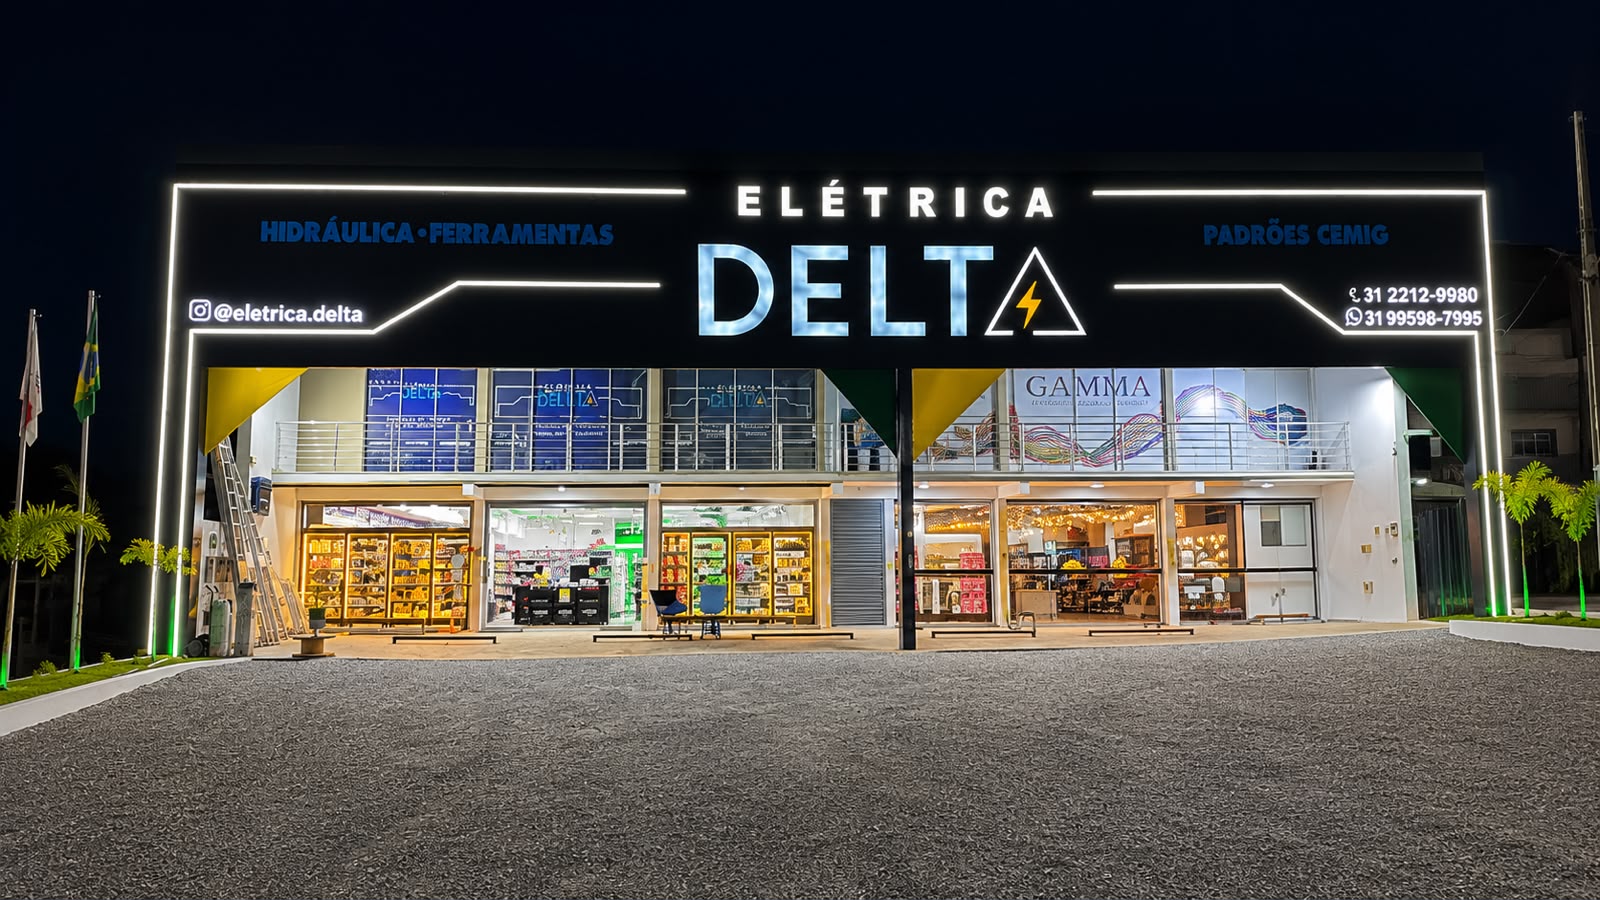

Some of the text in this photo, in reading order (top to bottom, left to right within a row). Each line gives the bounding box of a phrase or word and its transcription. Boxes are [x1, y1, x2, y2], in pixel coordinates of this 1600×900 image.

[738, 179, 1053, 218] ELÉTRICA
[260, 215, 614, 246] HIDRÁULICA FERRAMENTAS
[1203, 218, 1389, 246] PADRÕES CEMIG
[698, 244, 1087, 336] DELTA
[1364, 287, 1478, 303] 31 2212-9980
[214, 303, 363, 323] @eletrica.delta
[1364, 310, 1482, 326] 31 99598-7995
[1026, 375, 1151, 397] GAMMA
